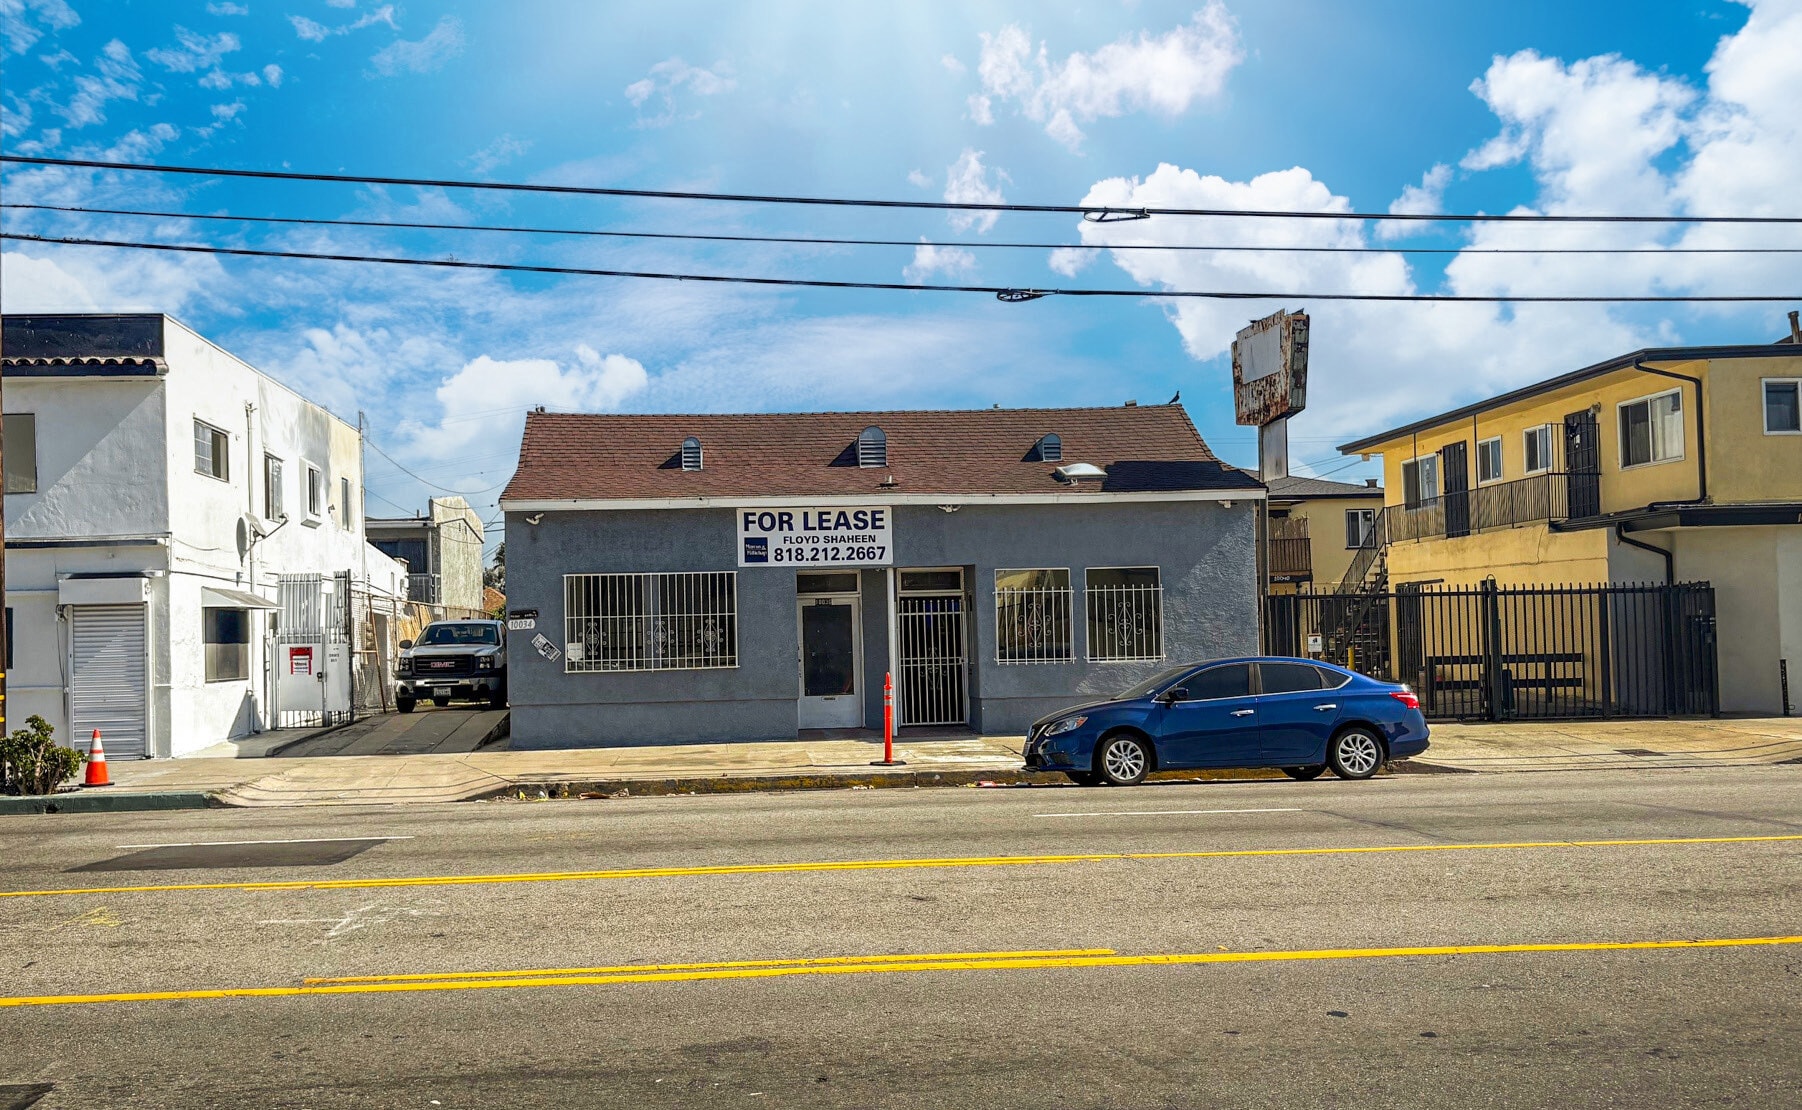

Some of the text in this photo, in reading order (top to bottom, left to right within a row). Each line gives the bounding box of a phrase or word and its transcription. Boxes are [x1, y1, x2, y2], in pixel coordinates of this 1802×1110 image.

[743, 510, 886, 532] FOR LEASE
[783, 535, 876, 544] FLOYD SHAHEEN
[774, 546, 886, 562] 818.212.2667
[510, 620, 533, 629] 10034
